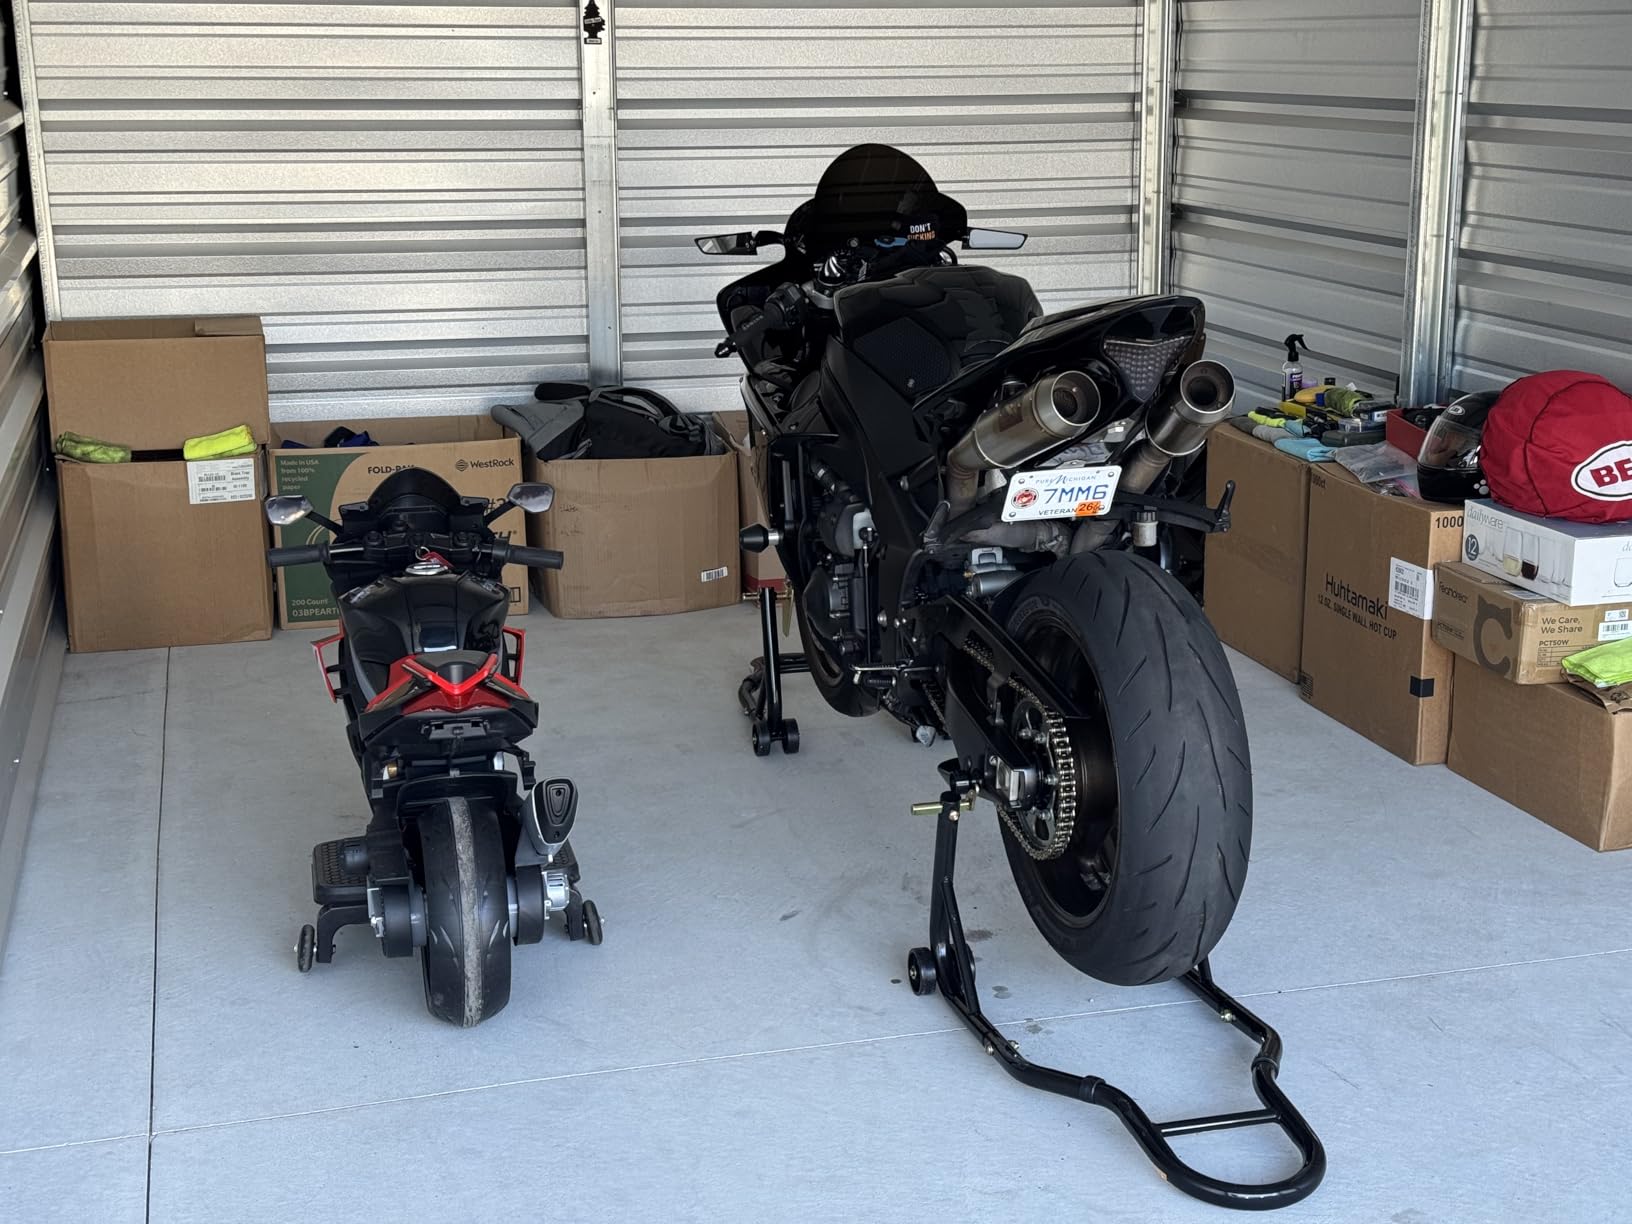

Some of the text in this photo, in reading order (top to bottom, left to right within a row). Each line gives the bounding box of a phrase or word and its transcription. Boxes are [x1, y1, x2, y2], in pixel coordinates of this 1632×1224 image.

[910, 222, 931, 233] DON'T
[470, 458, 515, 469] WestRock
[1043, 484, 1109, 505] 7MM6
[1038, 507, 1077, 516] VETERAN
[1078, 502, 1093, 512] 26
[1435, 515, 1464, 529] 1000
[1467, 505, 1504, 530] dailyware
[1468, 536, 1477, 555] 12
[1325, 572, 1388, 620] Huhtamaki
[291, 598, 329, 607] 200 Count
[1333, 602, 1352, 620] SINGLE
[1352, 611, 1368, 629] WALL
[1369, 620, 1382, 634] HOT
[1383, 626, 1397, 640] CUP
[1541, 616, 1581, 625] We Care,
[1540, 625, 1583, 634] We Share
[1538, 639, 1569, 647] PCT50W
